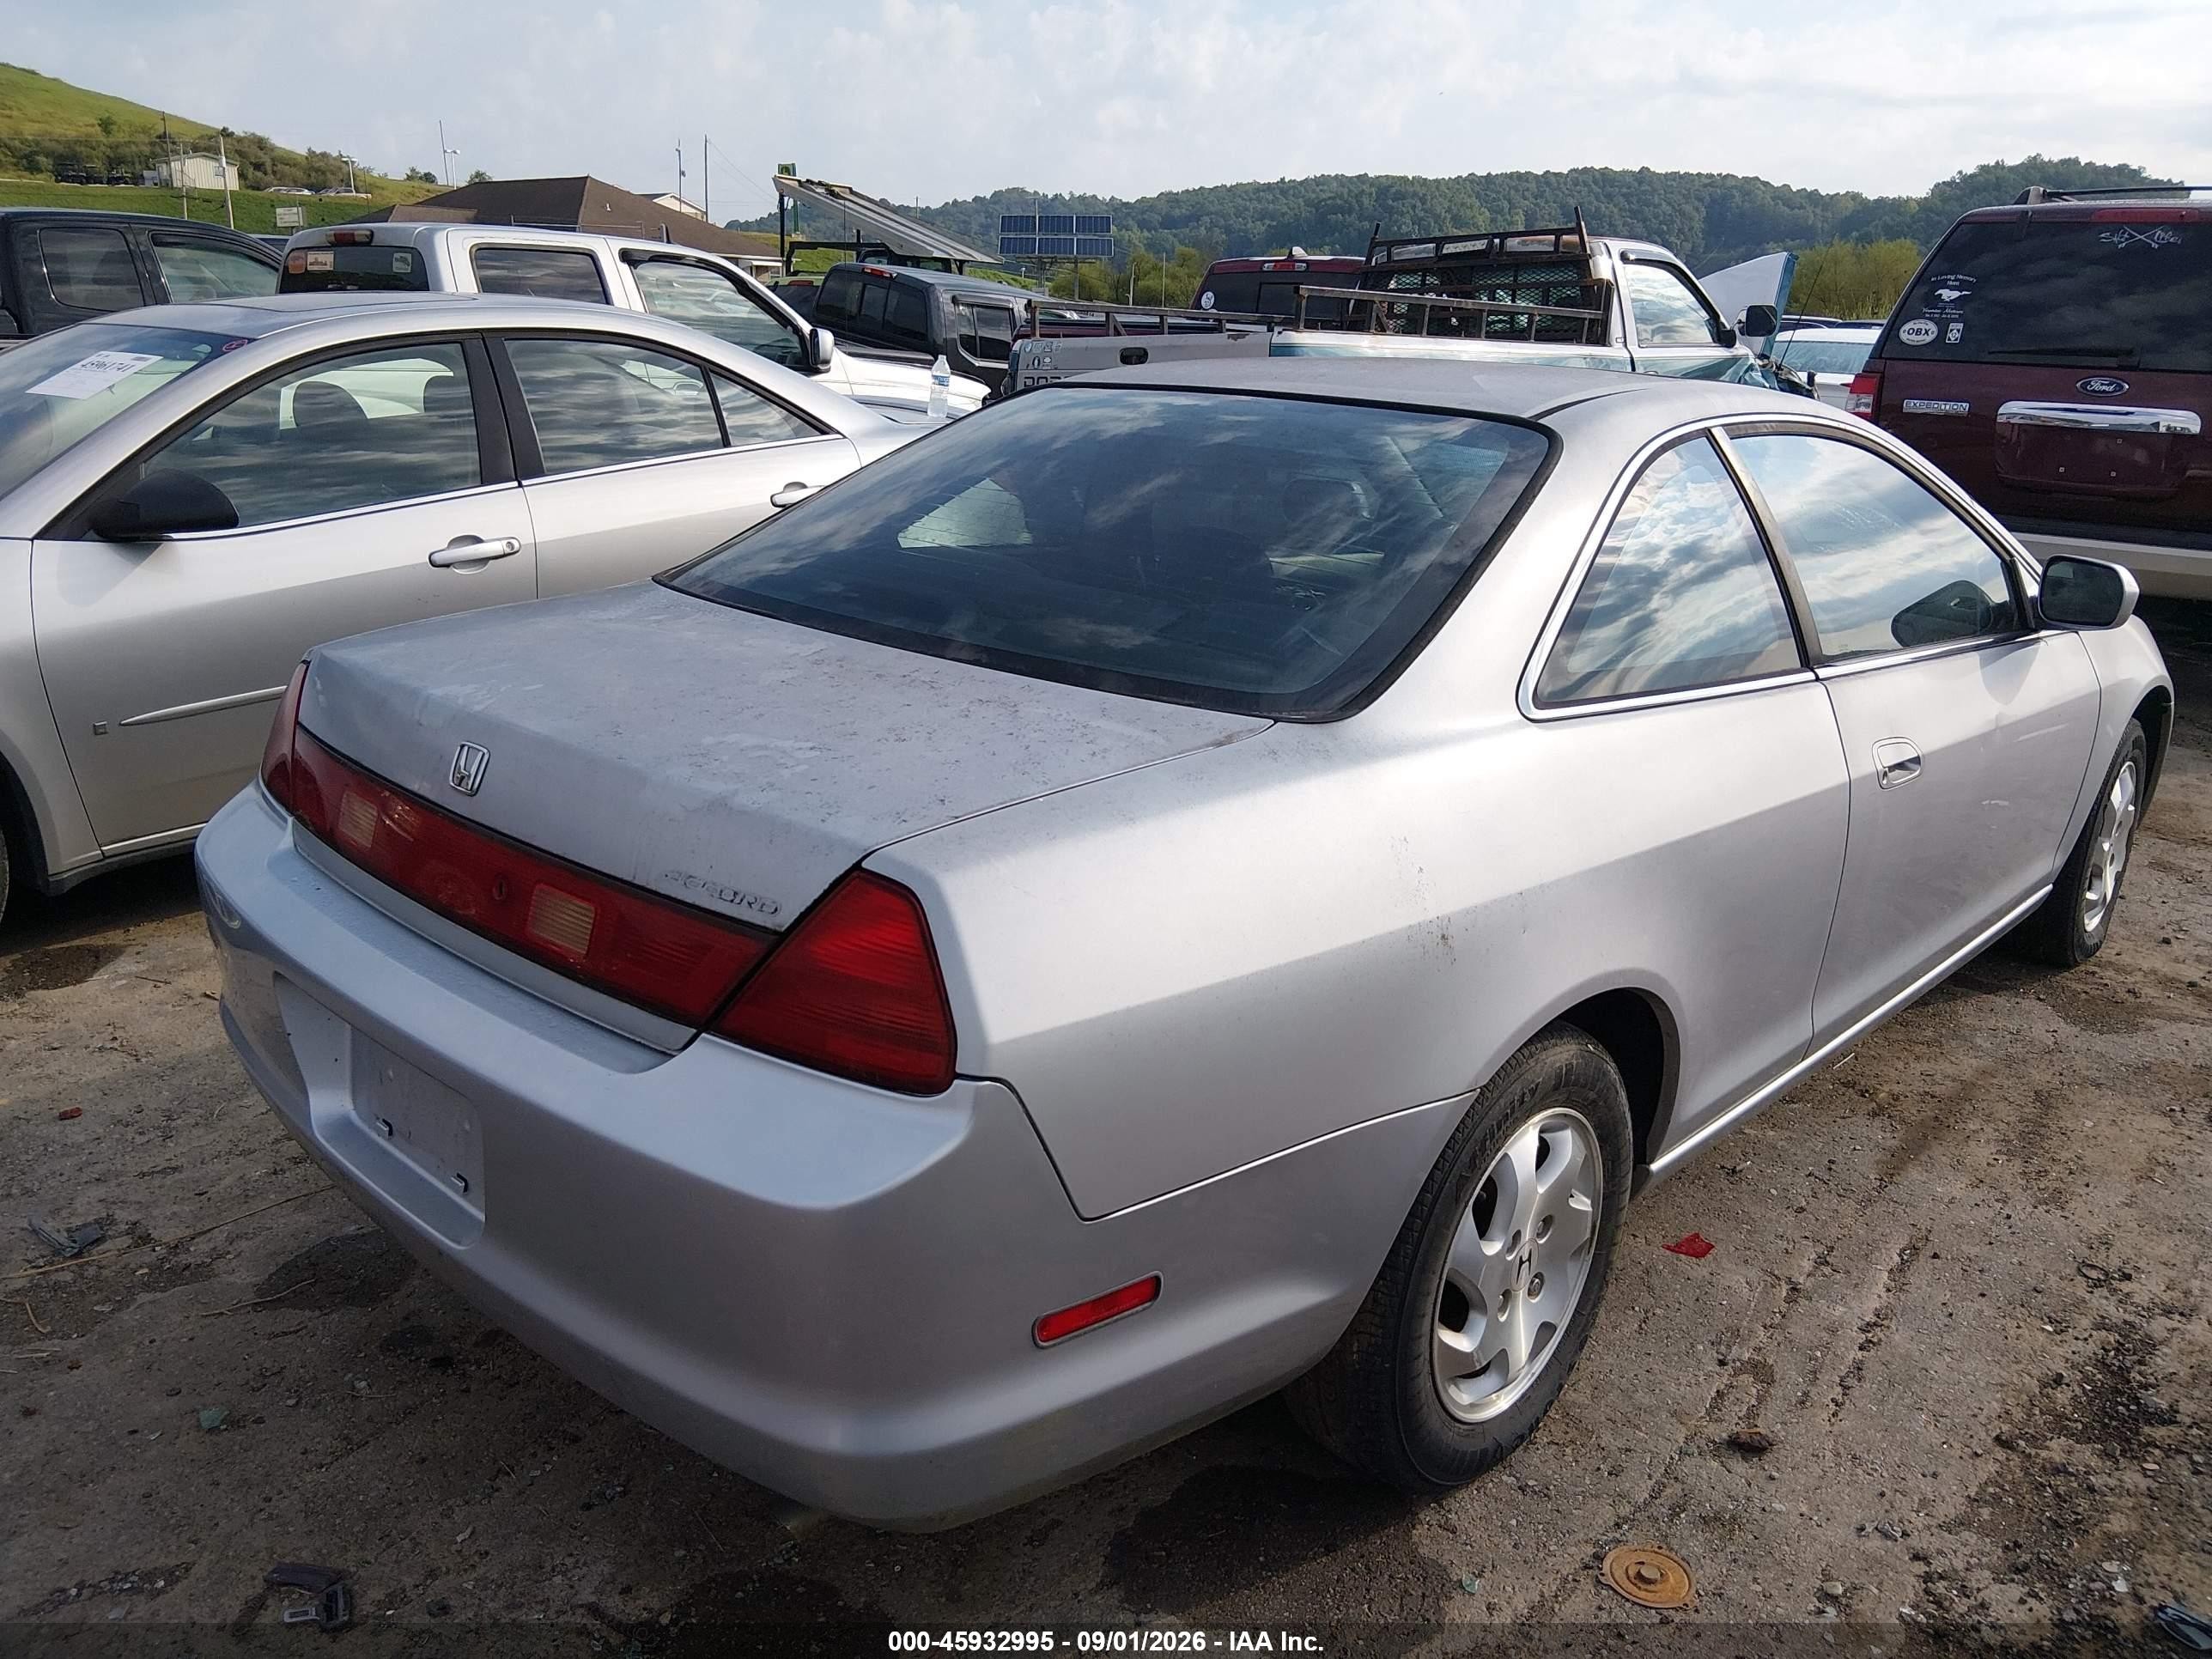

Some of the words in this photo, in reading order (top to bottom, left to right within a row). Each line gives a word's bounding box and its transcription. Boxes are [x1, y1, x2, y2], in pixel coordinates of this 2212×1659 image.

[1906, 327, 1931, 337] OBX
[2087, 379, 2117, 393] Ford
[1905, 401, 1968, 411] EXPEDITION
